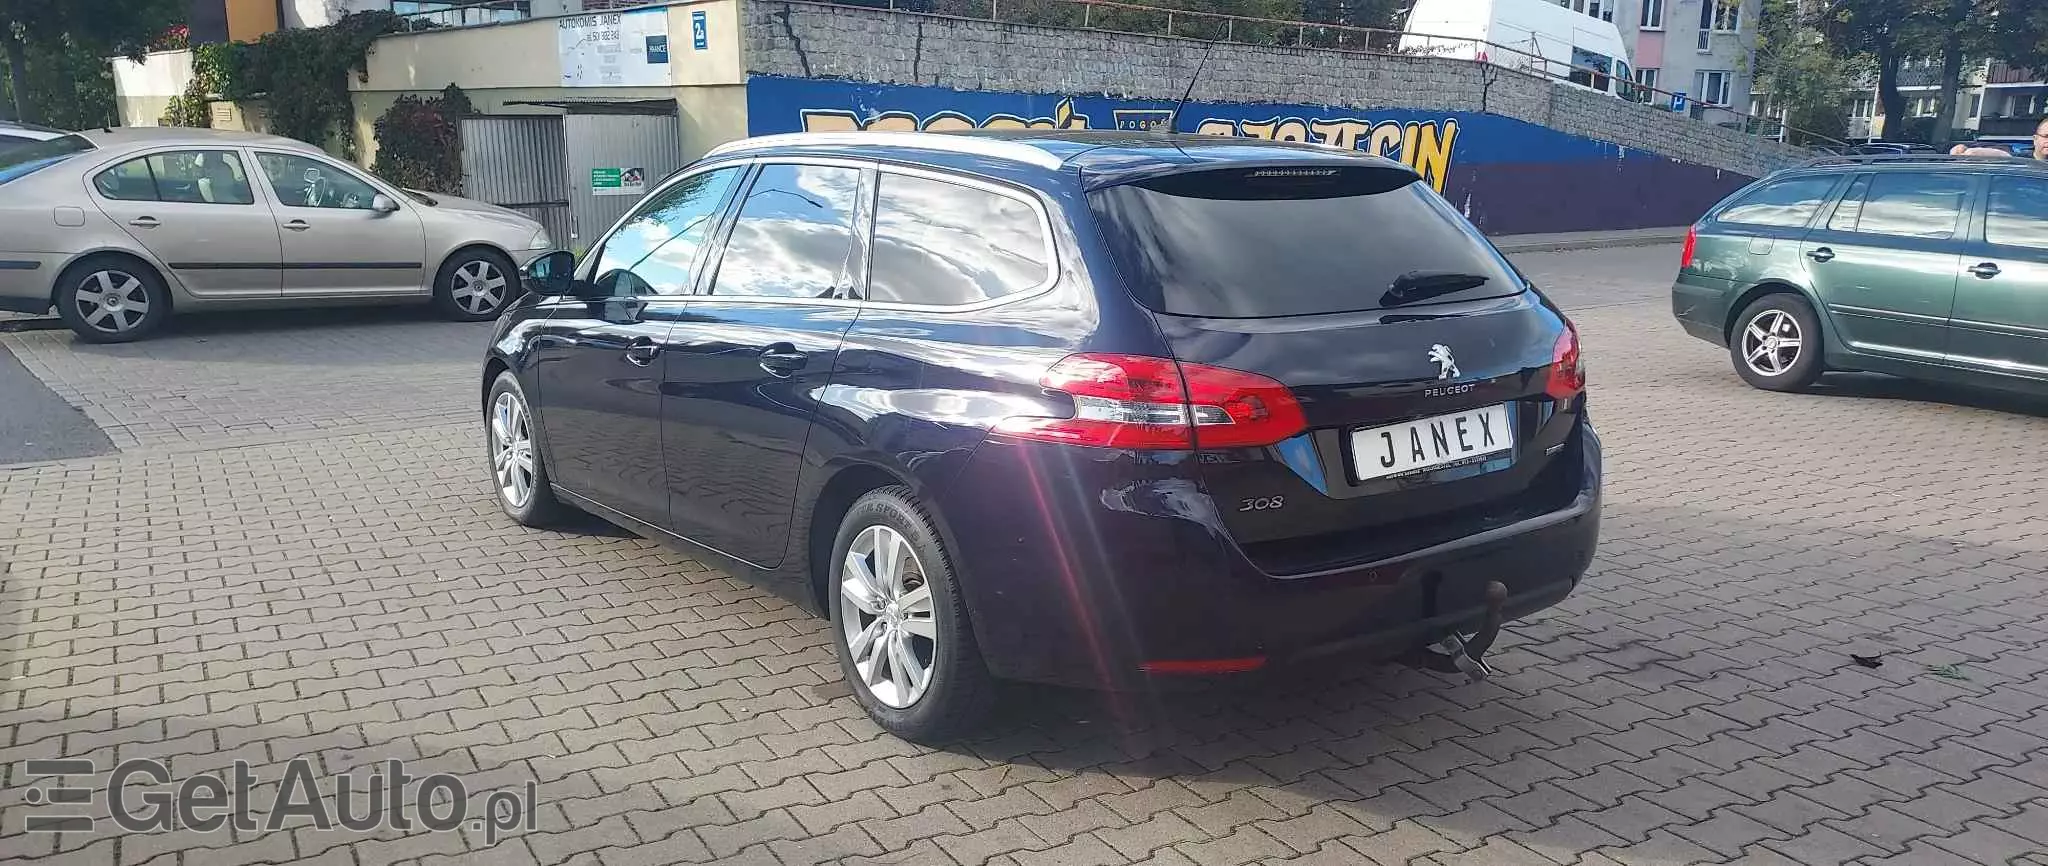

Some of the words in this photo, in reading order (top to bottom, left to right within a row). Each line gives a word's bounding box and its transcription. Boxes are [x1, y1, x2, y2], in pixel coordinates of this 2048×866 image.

[600, 13, 622, 25] JANEX
[1425, 383, 1475, 398] PEUGEOT
[1380, 412, 1495, 468] JANEX
[1239, 495, 1284, 511] 308
